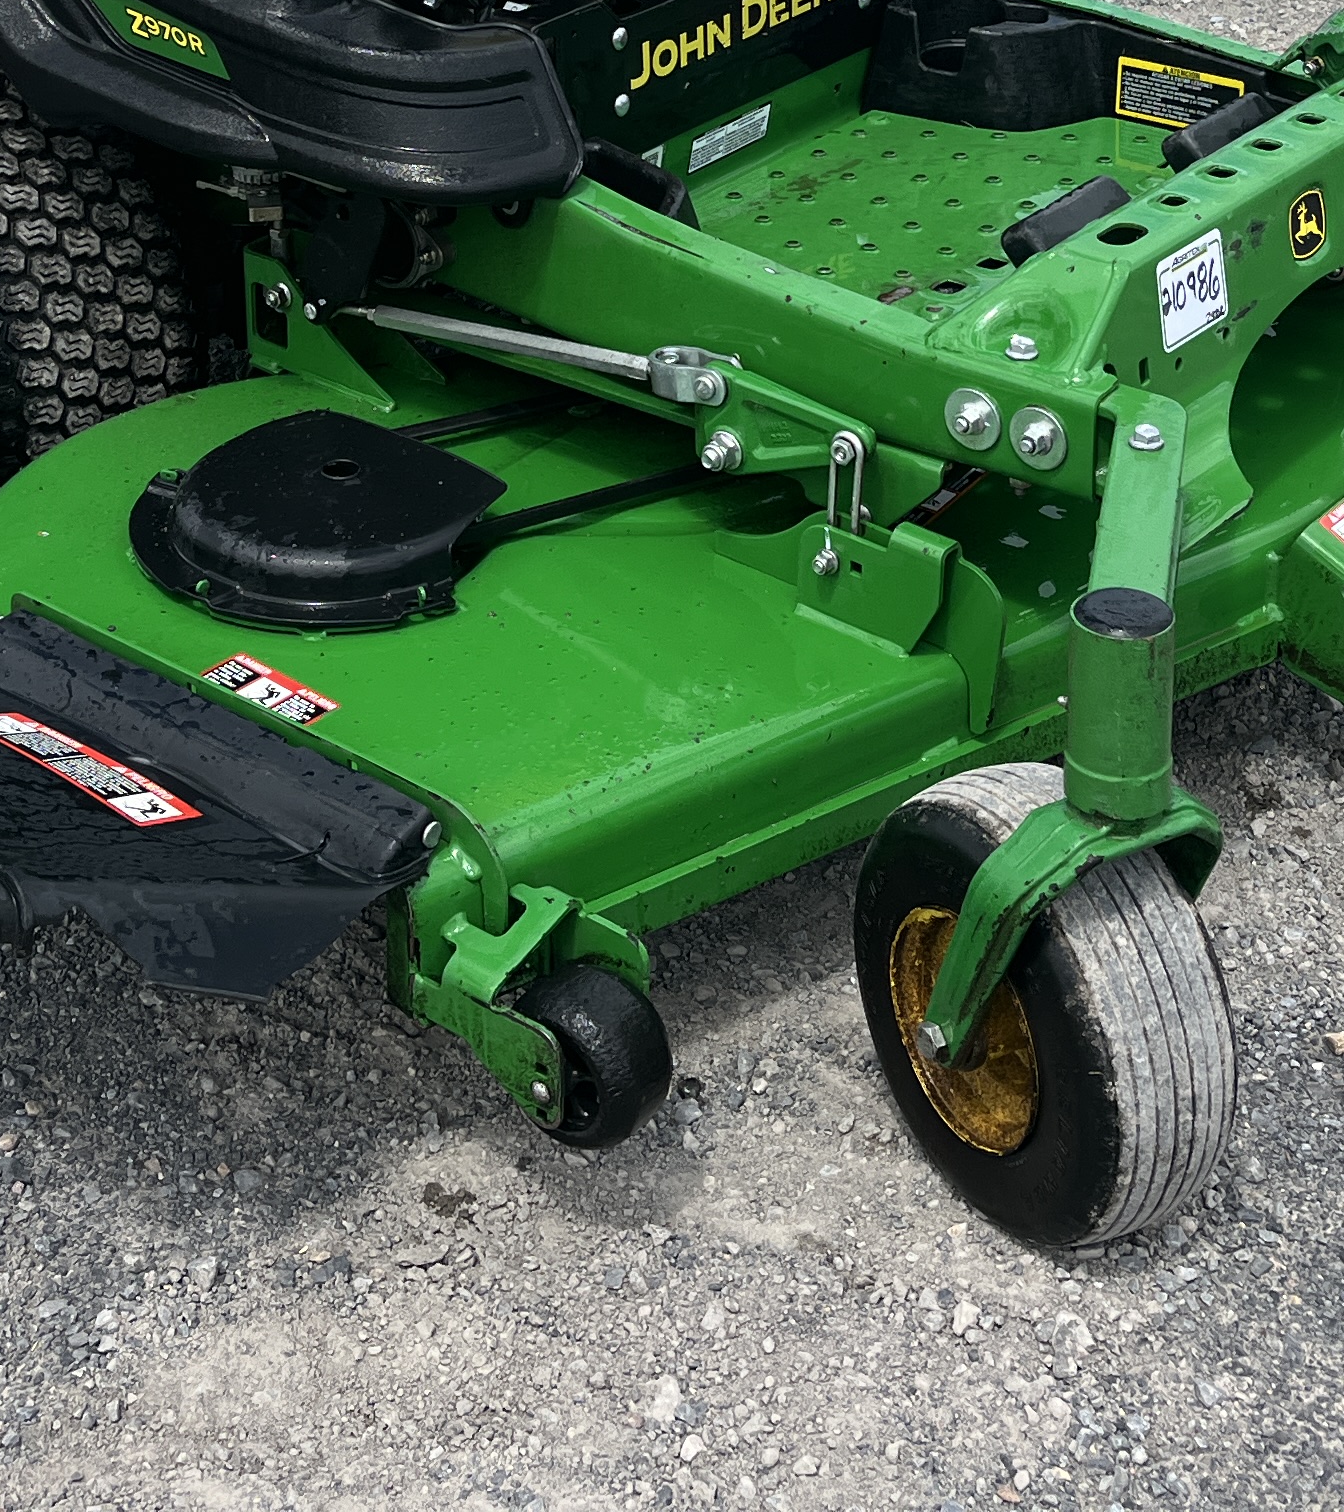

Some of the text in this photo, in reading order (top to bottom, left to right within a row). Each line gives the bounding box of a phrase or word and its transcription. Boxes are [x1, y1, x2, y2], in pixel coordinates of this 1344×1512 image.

[126, 7, 206, 56] Z970R
[630, 13, 731, 90] JOHN
[1162, 257, 1221, 316] 210986
